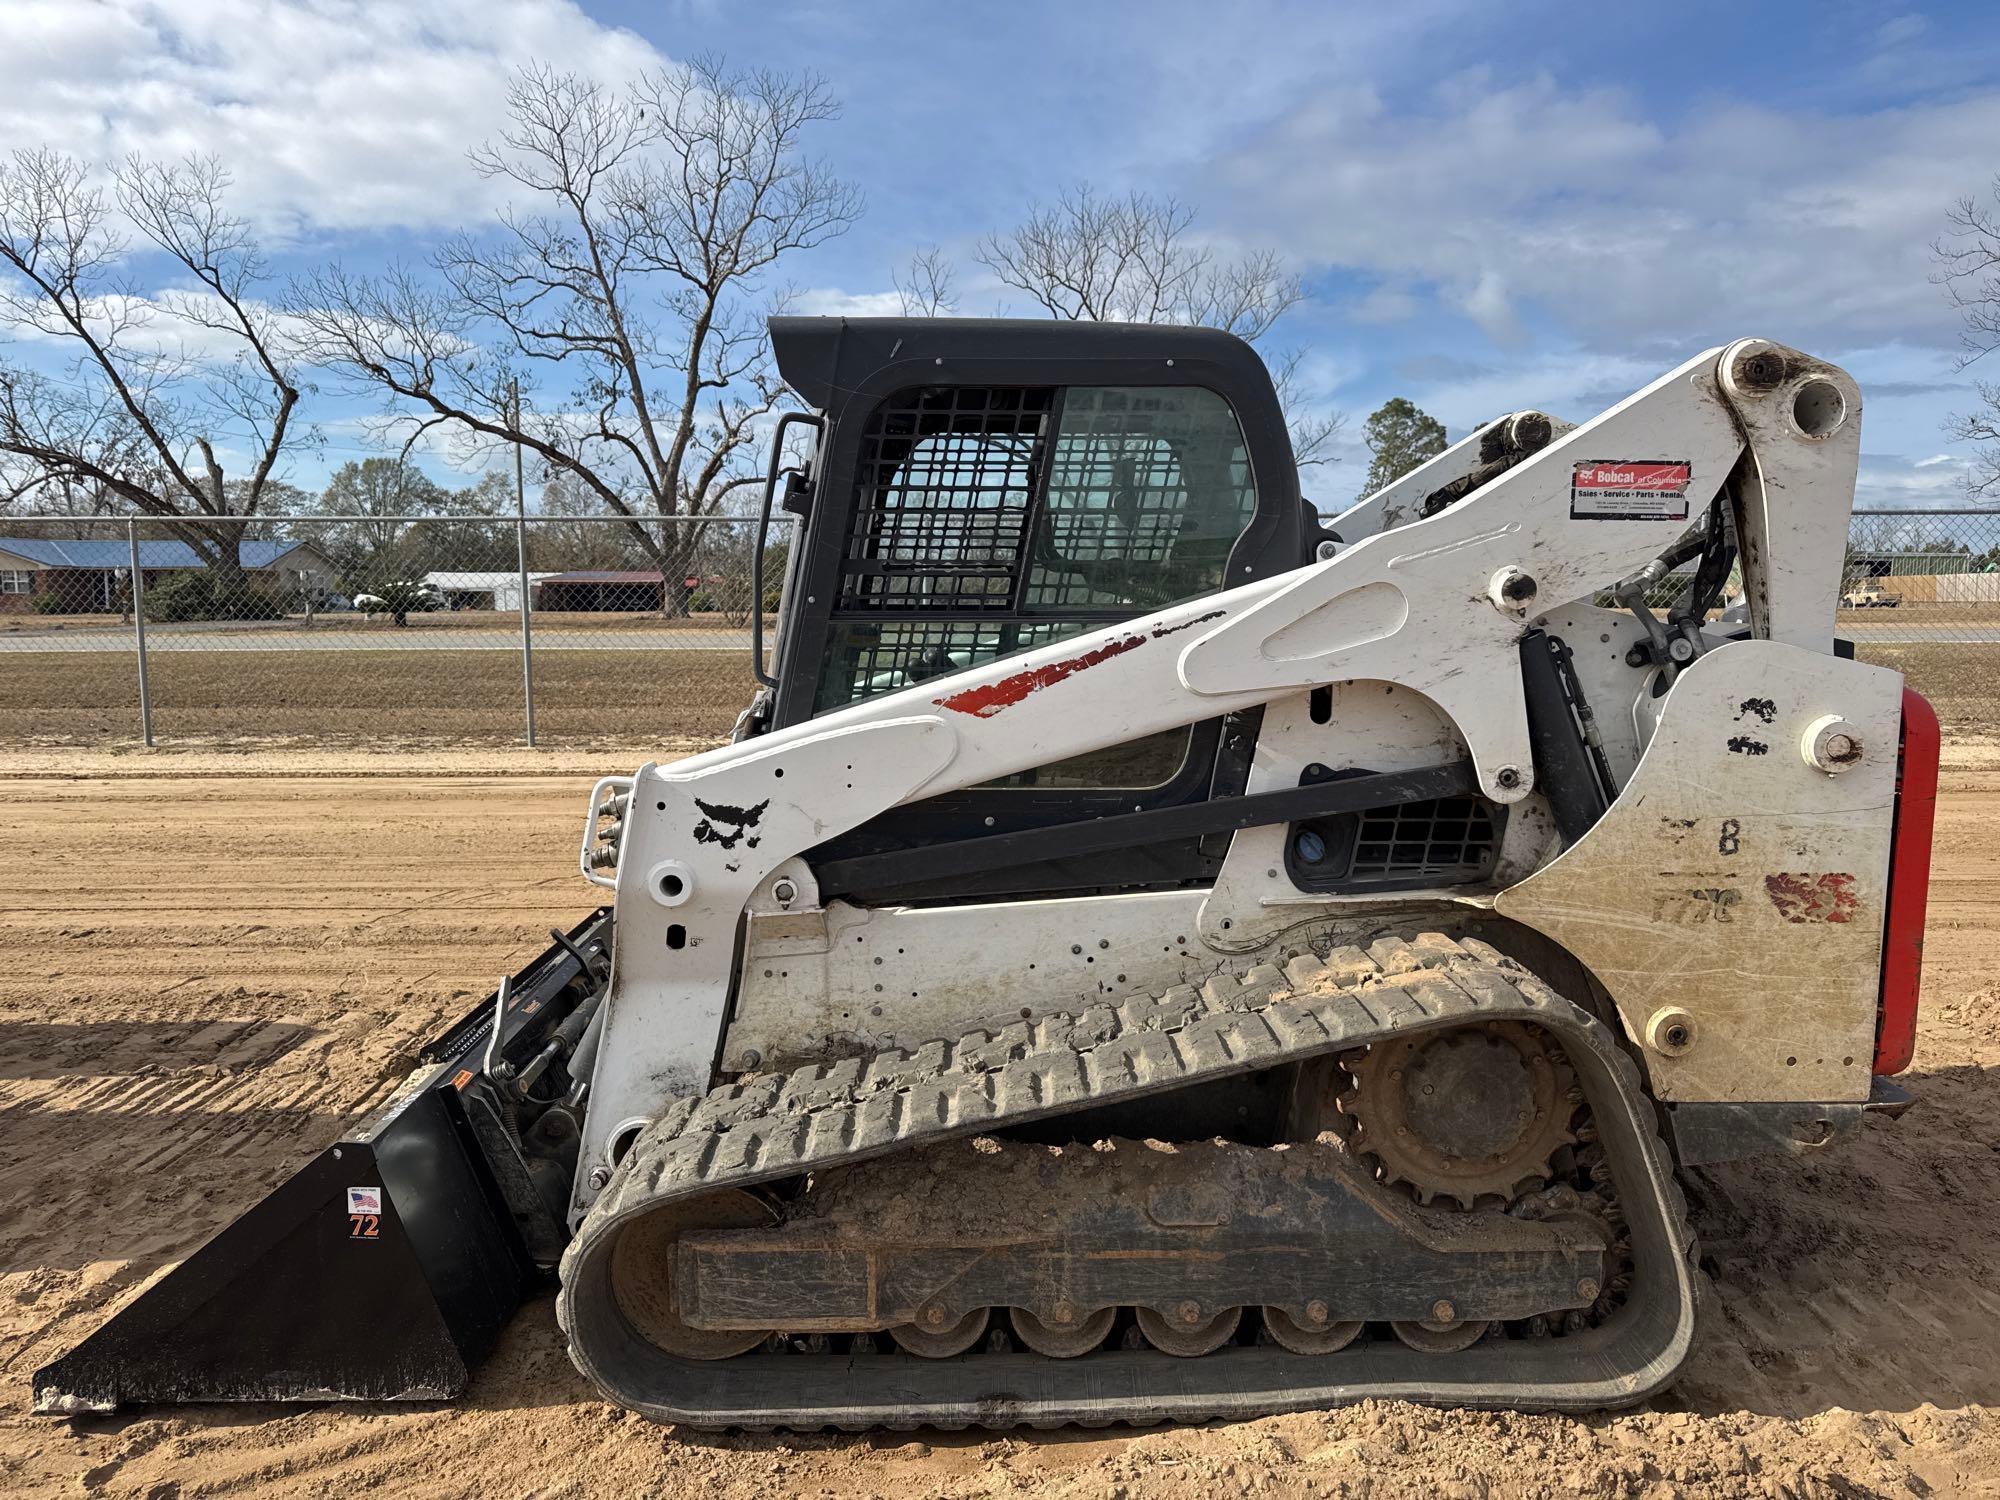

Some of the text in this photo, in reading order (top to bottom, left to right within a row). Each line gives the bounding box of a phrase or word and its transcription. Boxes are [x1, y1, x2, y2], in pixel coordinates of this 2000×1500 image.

[1597, 470, 1635, 483] Bobcat
[1578, 490, 1598, 498] Sales
[1603, 490, 1630, 498] Service
[1635, 491, 1655, 499] Parts
[350, 1214, 379, 1236] 72
